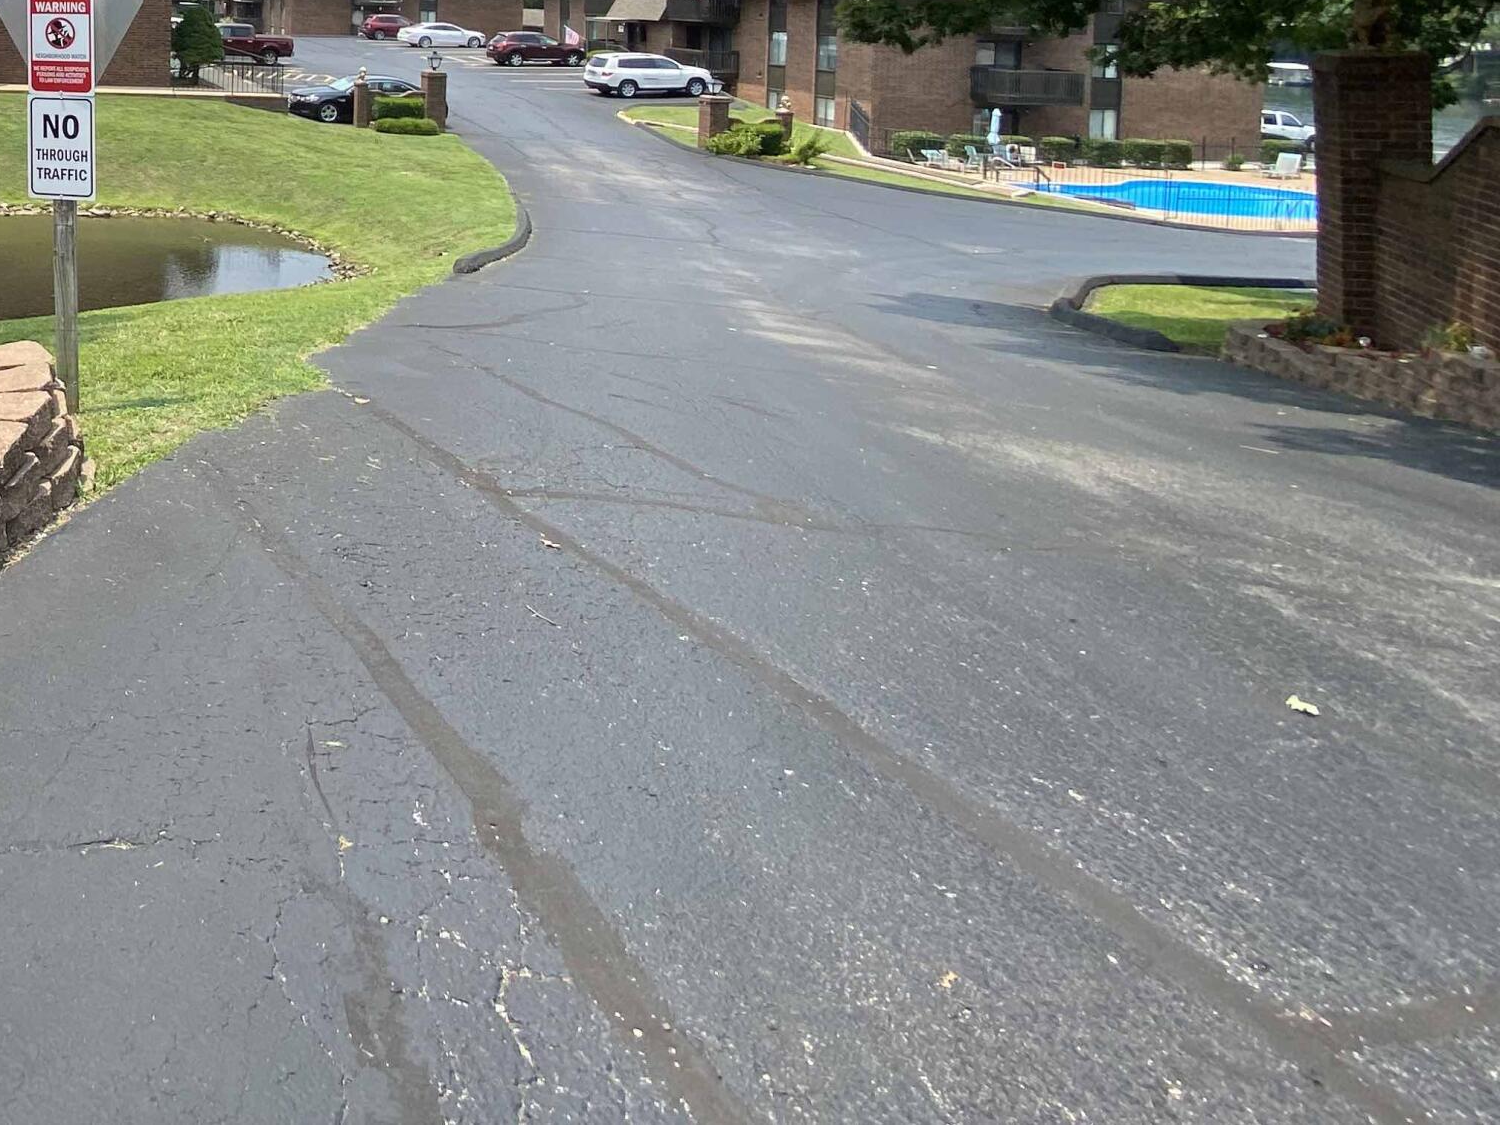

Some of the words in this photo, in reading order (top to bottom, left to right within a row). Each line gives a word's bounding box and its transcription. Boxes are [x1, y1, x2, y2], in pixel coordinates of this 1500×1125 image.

[35, 1, 86, 13] WARNING
[42, 113, 79, 139] NO
[36, 148, 88, 163] THROUGH
[37, 167, 88, 181] TRAFFIC
